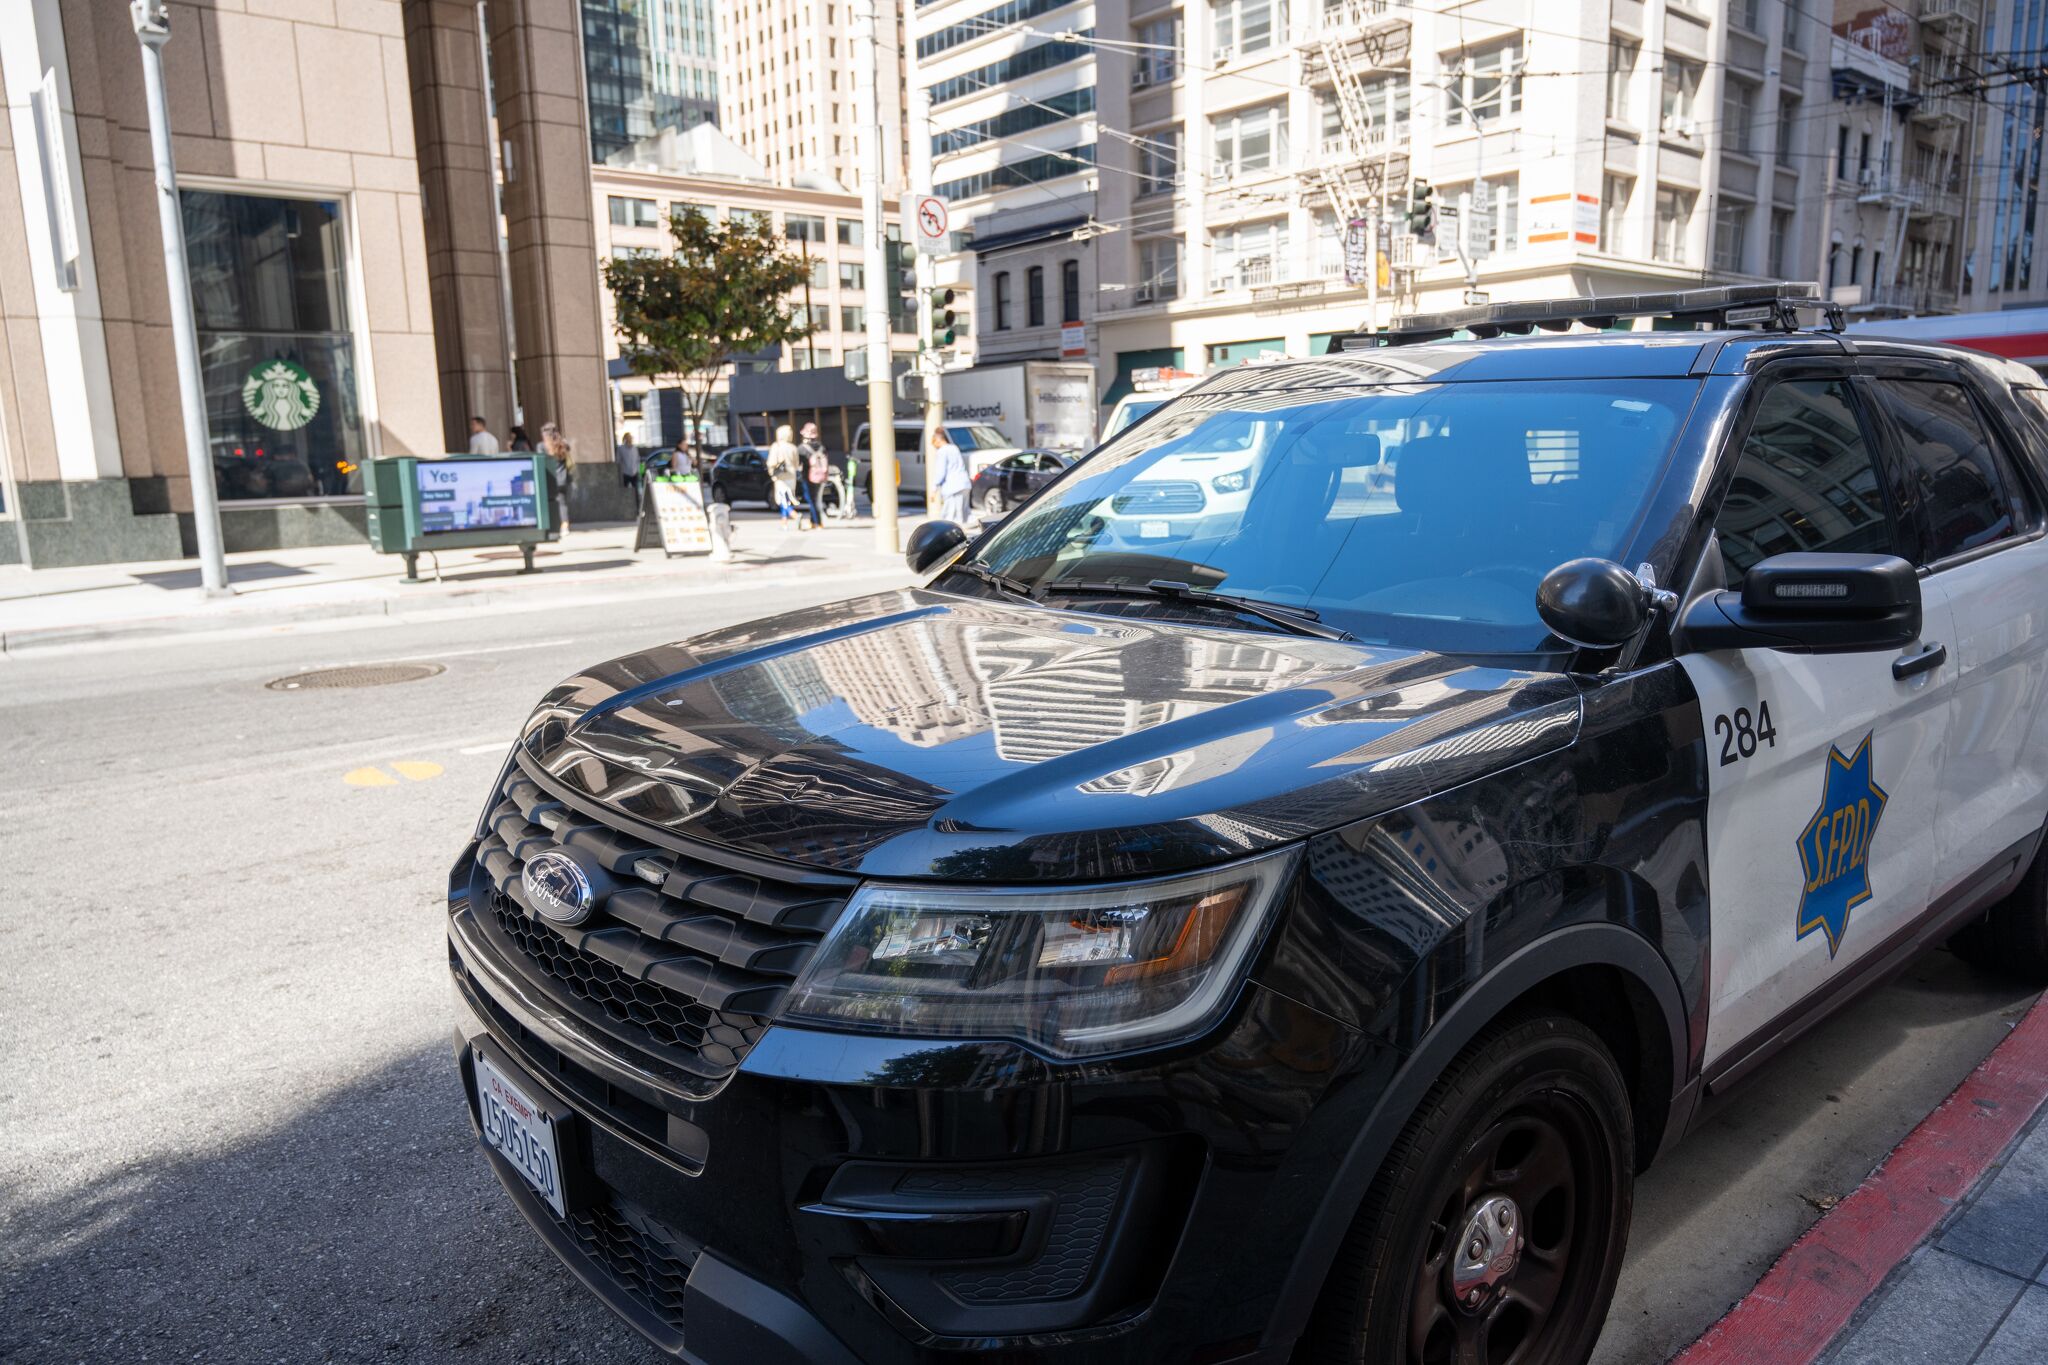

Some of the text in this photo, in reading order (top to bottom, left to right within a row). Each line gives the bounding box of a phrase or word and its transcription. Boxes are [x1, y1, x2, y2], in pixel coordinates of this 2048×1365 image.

[946, 402, 1001, 420] Hillebrand
[1039, 392, 1082, 404] Hillebrand
[429, 469, 459, 483] Yes
[1714, 700, 1777, 767] 284
[1807, 797, 1870, 893] S.F.P.D.
[528, 861, 569, 908] Ford
[492, 1078, 533, 1125] CA EXEMPT
[483, 1088, 555, 1197] 1505150
